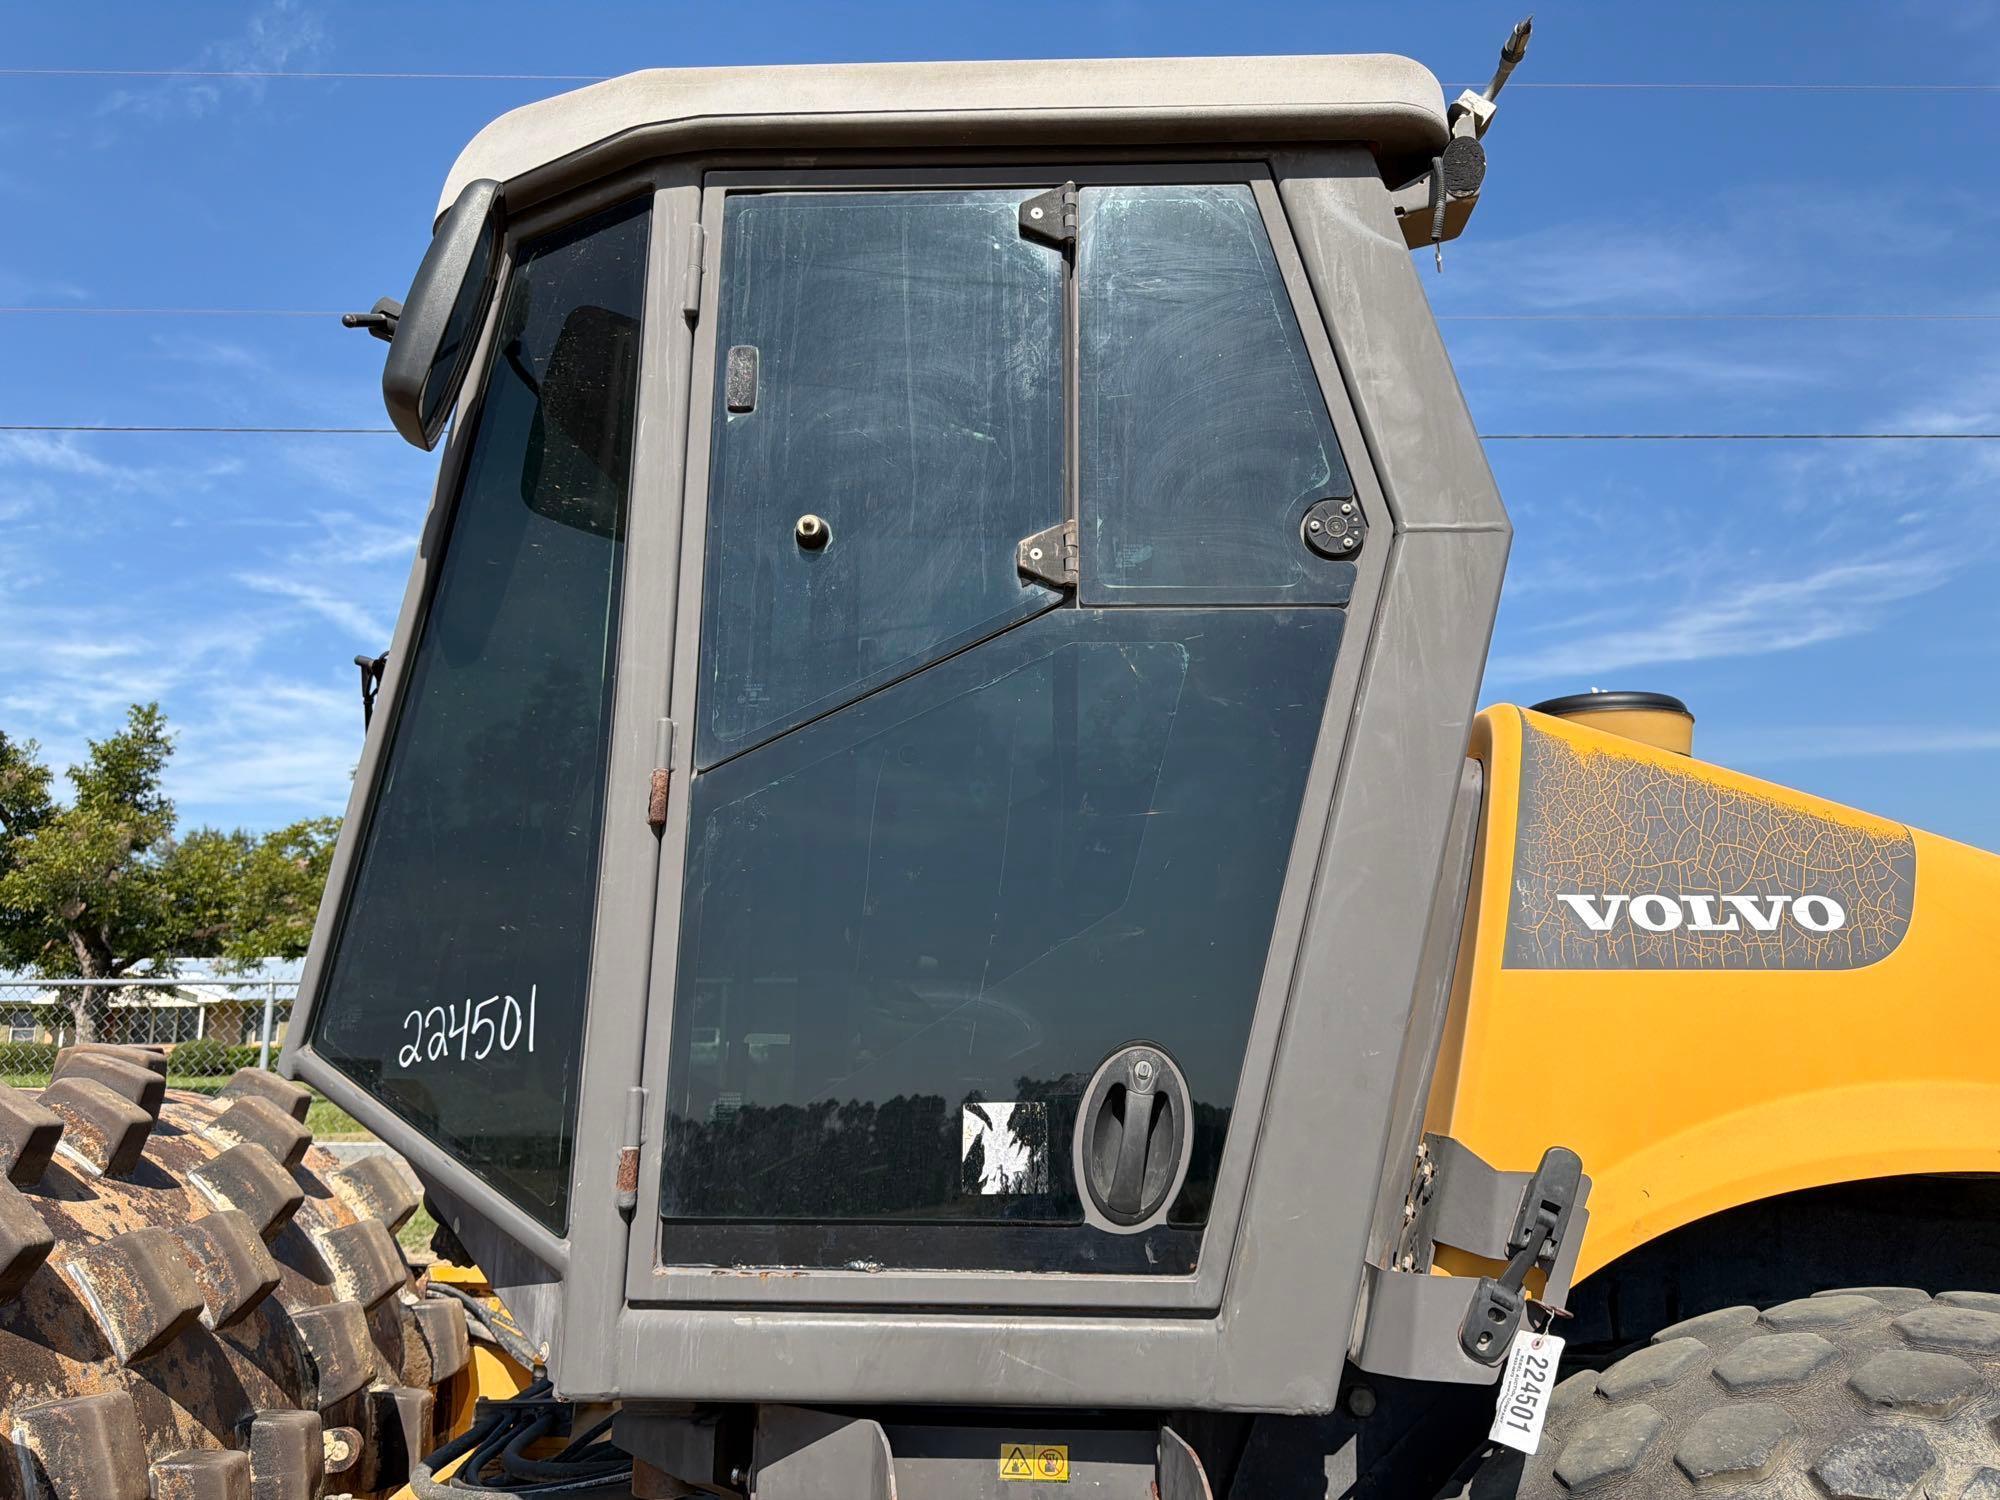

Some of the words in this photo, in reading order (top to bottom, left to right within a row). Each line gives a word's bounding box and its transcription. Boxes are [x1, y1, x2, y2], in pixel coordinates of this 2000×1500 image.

[1557, 894, 1846, 932] VOLVO
[399, 984, 537, 1067] 224501
[1506, 1354, 1548, 1433] 224501
[1510, 1373, 1520, 1397] AUCTION
[1499, 1397, 1511, 1423] COMPANY
